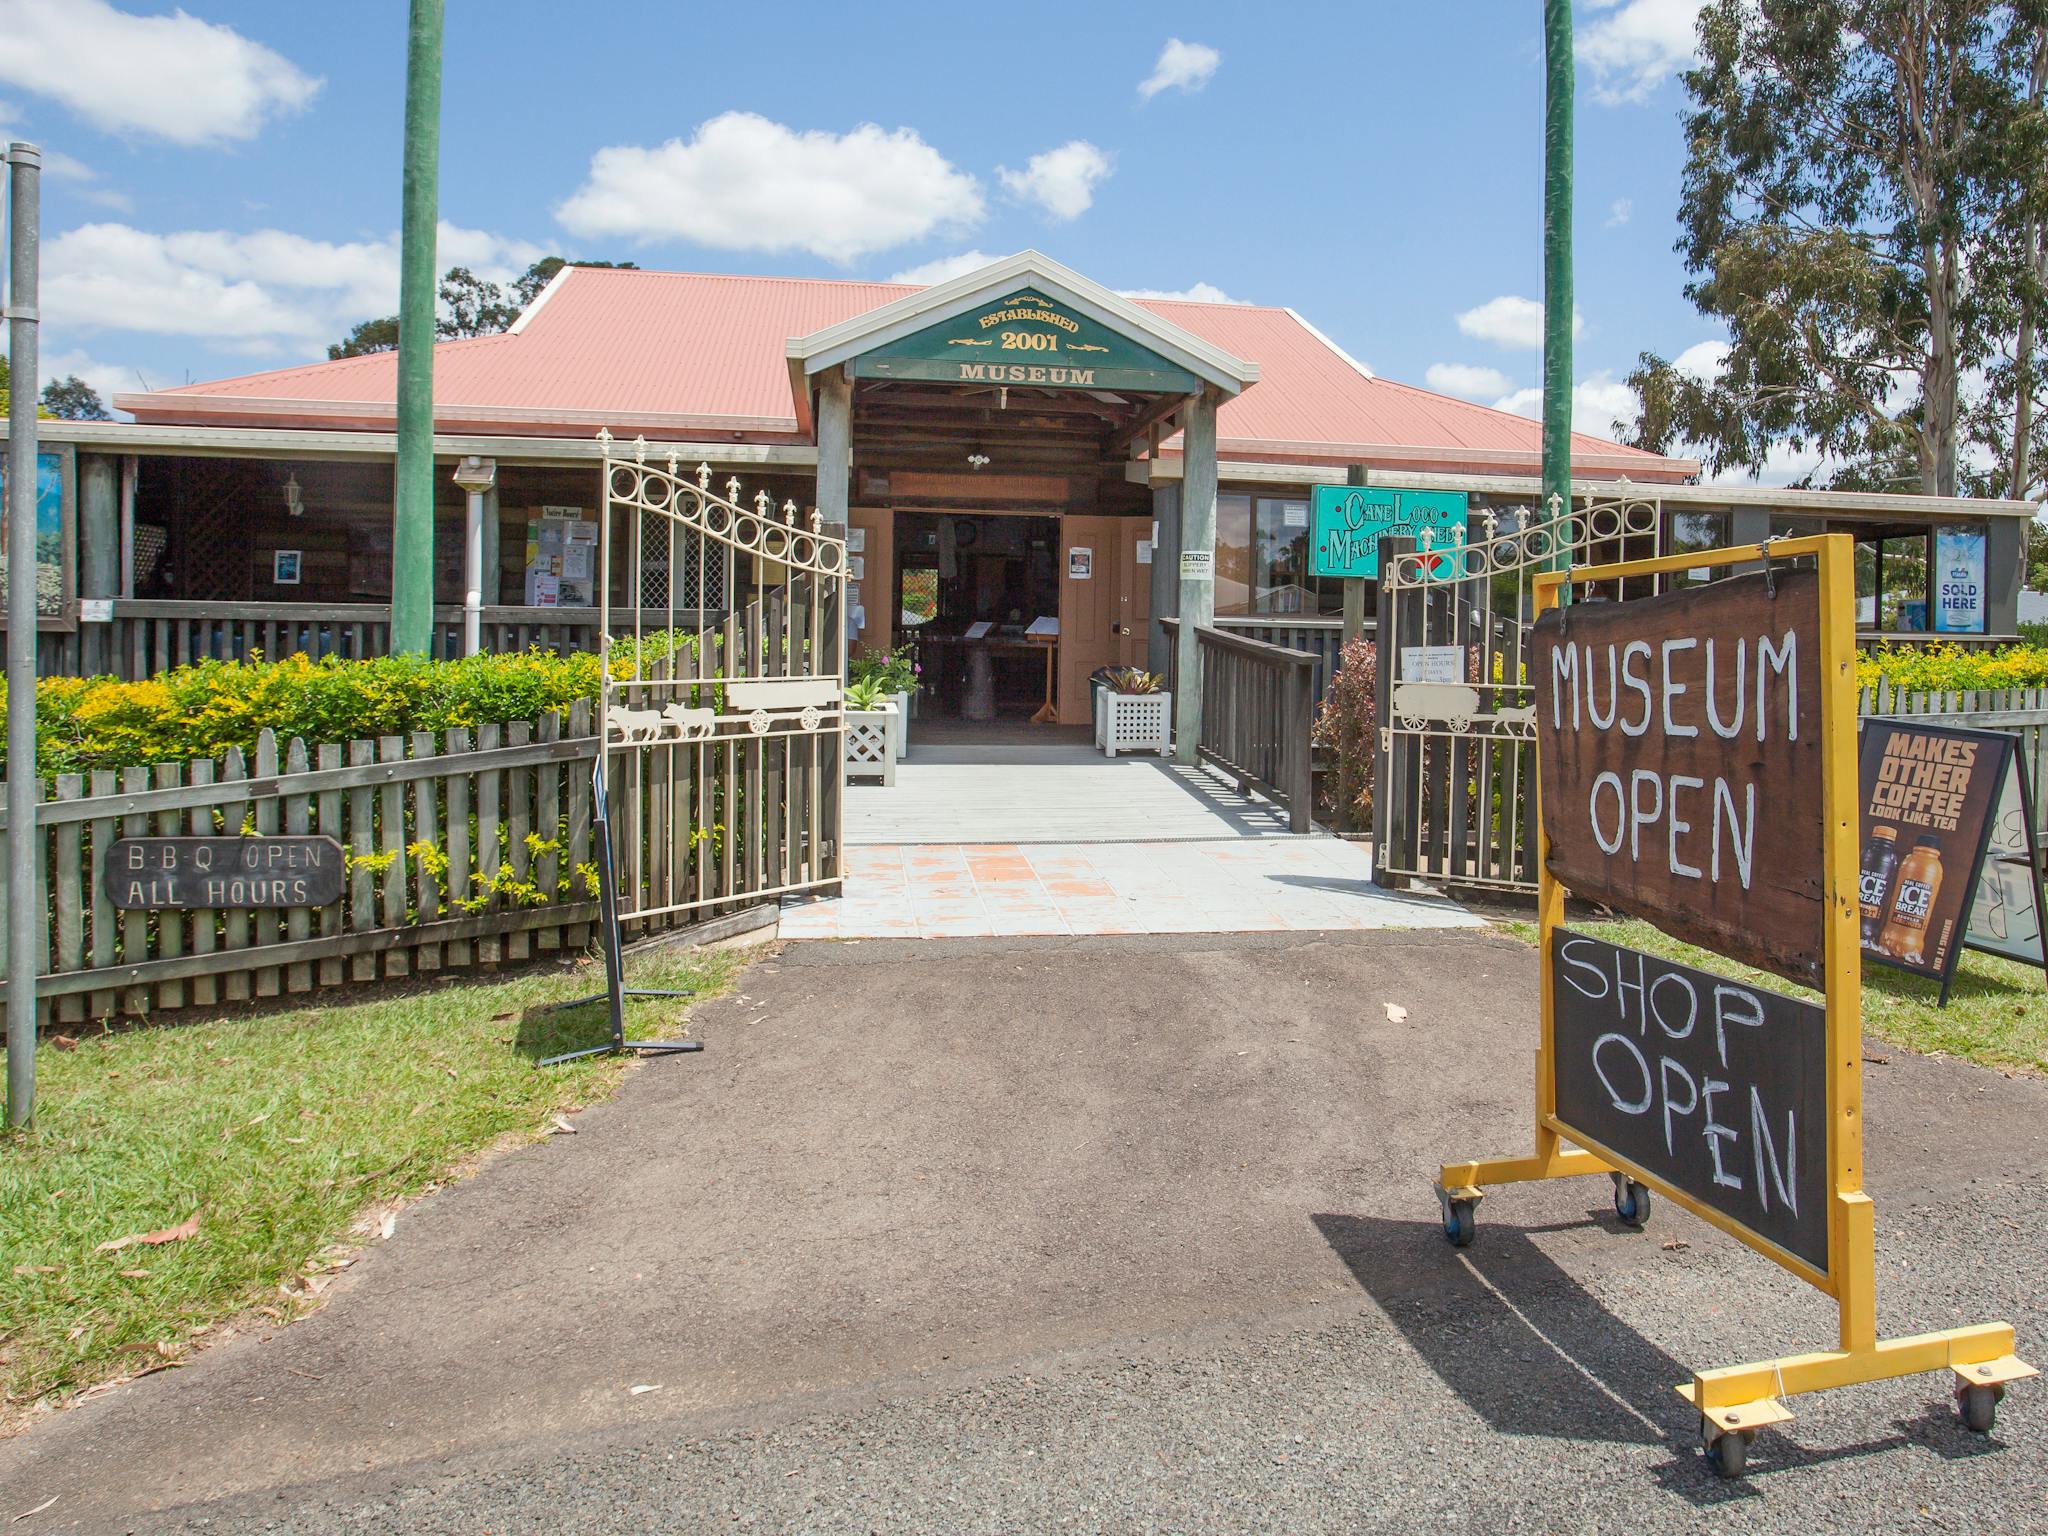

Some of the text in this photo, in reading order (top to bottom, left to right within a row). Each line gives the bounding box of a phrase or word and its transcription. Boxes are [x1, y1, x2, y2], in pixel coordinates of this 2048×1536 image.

[978, 308, 1080, 333] ESTABLISHED
[1001, 331, 1058, 351] 2001
[959, 363, 1095, 385] MUSEUM
[1942, 584, 1977, 596] SOLD
[1942, 597, 1977, 610] HERE
[1551, 627, 1798, 742] MUSEUM
[1884, 732, 1979, 768] MAKES
[1878, 755, 1972, 795] OTHER
[1872, 781, 1966, 819] COFFEE
[1589, 768, 1755, 889] OPEN
[1868, 803, 1957, 831] LOOK LIKE TEA
[246, 845, 321, 868] OPEN
[127, 880, 308, 905] ALL HOURS
[1860, 893, 1881, 906] REAK
[1898, 884, 1932, 908] ICE
[1895, 902, 1927, 917] BREAK
[1937, 947, 1945, 957] IT
[1562, 939, 1765, 1070] SHOP
[1592, 1032, 1798, 1219] OPEN
